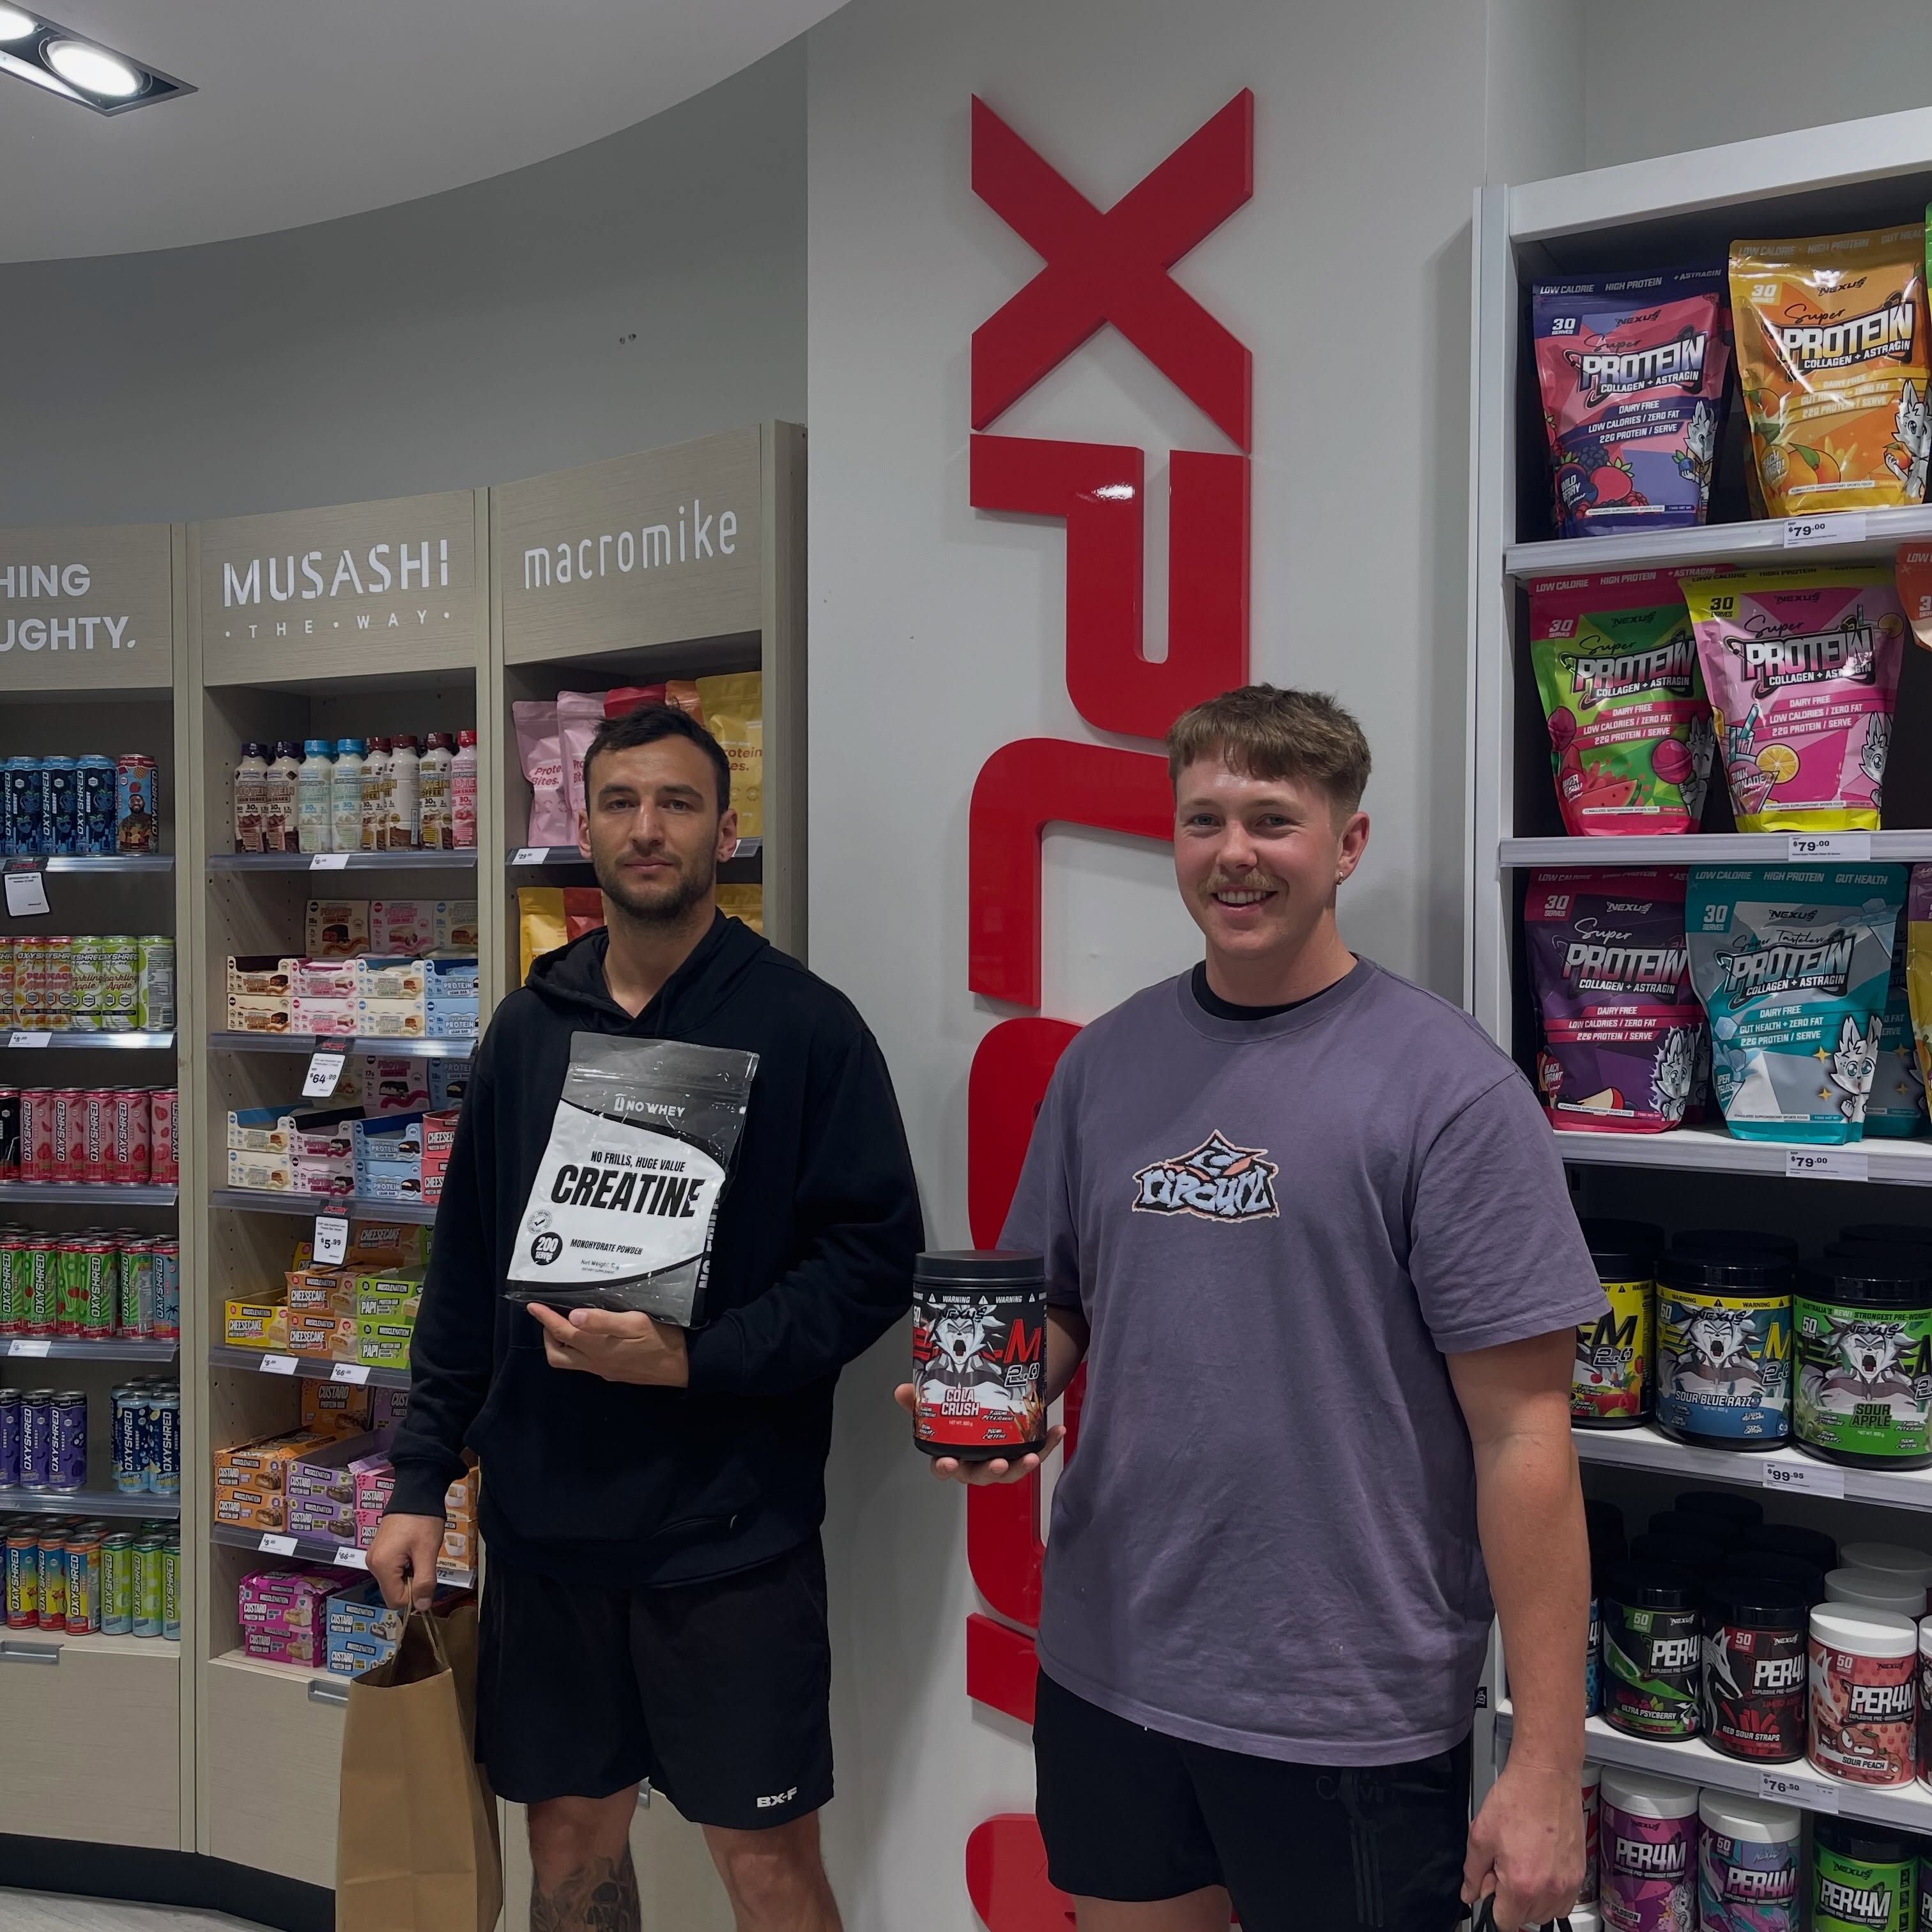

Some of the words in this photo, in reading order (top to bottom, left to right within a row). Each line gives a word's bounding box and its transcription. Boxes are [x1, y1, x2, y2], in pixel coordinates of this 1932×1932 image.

[1540, 286, 1560, 295] LOW
[1562, 284, 1595, 294] CALORIE
[1605, 282, 1626, 291] HIGH
[1627, 277, 1662, 289] PROTEIN
[1751, 284, 1777, 297] 30
[1552, 318, 1576, 330] 30
[1615, 310, 1661, 326] NEXUS
[1782, 303, 1913, 360] PROTEIN
[1584, 333, 1641, 353] Super
[1579, 335, 1705, 390] PROTEIN
[1804, 356, 1852, 369] COLLAGEN
[1864, 340, 1910, 359] ASTRAGIN
[1600, 381, 1644, 394] COLLAGEN
[1655, 371, 1699, 385] ASTRAGIN
[1619, 402, 1641, 414] DAIRY
[1642, 400, 1660, 411] FREE
[1588, 424, 1607, 433] LOW
[1607, 416, 1641, 429] CALORIES
[1648, 412, 1666, 422] ZERO
[1667, 410, 1680, 418] FAT
[1599, 433, 1615, 444] 22G
[1616, 428, 1647, 440] PROTEIN
[1653, 424, 1677, 434] SERVE
[1788, 523, 1825, 537] $79.00
[524, 499, 738, 590] macromike
[224, 539, 448, 608] MUSASHI
[1710, 597, 1734, 611] 30
[249, 619, 313, 639] THE
[356, 610, 427, 630] WAY
[1549, 620, 1574, 632] 30
[1744, 615, 1804, 638] Super
[1579, 635, 1636, 654] Super
[1744, 628, 1873, 680] PROTEIN
[1573, 641, 1696, 692] PROTEIN
[1597, 682, 1640, 697] COLLAGEN
[1650, 676, 1690, 687] ASTRAGIN
[1769, 673, 1814, 686] COLLAGEN
[1790, 698, 1812, 709] DAIRY
[1813, 695, 1831, 705] FREE
[1770, 714, 1788, 724] LOW
[1788, 709, 1825, 721] CALORIES
[1831, 705, 1849, 714] ZERO
[1850, 703, 1863, 712] FAT
[1772, 726, 1788, 737] 22G
[1790, 721, 1821, 734] PROTEIN
[1828, 717, 1852, 728] SERVE
[1793, 840, 1830, 852] $79.00
[1696, 871, 1716, 880] LOW
[1717, 871, 1753, 880] CALORIE
[1763, 871, 1787, 881] HIGH
[1788, 872, 1825, 882] PROTEIN
[1835, 873, 1854, 884] GUT
[1855, 875, 1888, 885] HEALTH
[1544, 895, 1570, 910] 30
[1606, 901, 1653, 914] NEXUS
[1703, 905, 1728, 923] 30
[1768, 909, 1818, 921] NEXUS
[1574, 917, 1632, 944] Super
[1563, 943, 1687, 983] PROTEIN
[1726, 935, 1855, 992] PROTEIN
[1579, 979, 1623, 992] COLLAGEN
[1634, 983, 1675, 994] ASTRAGIN
[1746, 979, 1789, 996] COLLAGEN
[1799, 974, 1844, 987] ASTRAGIN
[1759, 1008, 1781, 1018] DAIRY
[1781, 1006, 1802, 1016] FREE
[1739, 1024, 1754, 1034] GUT
[1756, 1021, 1781, 1032] HEALTH
[1789, 1018, 1810, 1028] ZERO
[1811, 1016, 1824, 1027] FAT
[309, 1073, 337, 1084] $64.99
[90, 1101, 99, 1162] OXYSHRED
[119, 1101, 127, 1163] OXYSHRED
[591, 1151, 603, 1163] NO
[604, 1153, 633, 1169] FRILLS,
[635, 1157, 659, 1170] HUGE
[661, 1159, 686, 1172] VALUE
[1791, 1156, 1828, 1168] $79.00
[373, 1183, 401, 1191] PROTEIN
[551, 1164, 706, 1218] CREATINE
[321, 1237, 341, 1249] $5.99
[535, 1236, 558, 1253] 200
[571, 1238, 616, 1252] MONOHYDRATE
[618, 1245, 643, 1255] POWDER
[35, 1254, 45, 1314] OXYSHRED
[91, 1257, 101, 1318] OXYSHRED
[291, 1289, 326, 1302] CHEESECAKE
[942, 1295, 970, 1303] WARNING
[995, 1295, 1023, 1304] WARNING
[360, 1301, 376, 1315] PAPI
[1742, 1301, 1771, 1309] WARNING
[1833, 1308, 1853, 1318] NEW!
[1854, 1312, 1893, 1321] STRONGEST
[228, 1319, 263, 1331] CHEESECAKE
[1802, 1315, 1818, 1334] 50
[362, 1344, 378, 1358] PAPI
[1593, 1346, 1634, 1367] 2.0
[1004, 1362, 1040, 1388] 2.0
[318, 1384, 350, 1400] CUSTARD
[946, 1388, 975, 1402] COLA
[1675, 1391, 1699, 1404] SOUR
[1700, 1393, 1726, 1406] BLUE
[1728, 1395, 1752, 1407] RAZZ
[941, 1402, 980, 1416] CRUSH
[1855, 1404, 1891, 1416] SOUR
[1851, 1414, 1892, 1428] APPLE
[125, 1411, 133, 1471] OXYSHRED
[290, 1476, 311, 1489] CUSTARD
[1767, 1468, 1804, 1482] $99.95
[362, 1490, 384, 1501] CUSTARD
[11, 1549, 20, 1610] OXYSHRED
[71, 1554, 79, 1616] OXYSHRED
[1735, 1632, 1751, 1646] 50
[1851, 1680, 1915, 1713] PER4M
[1621, 1705, 1639, 1715] ULTRA
[1639, 1708, 1677, 1720] PSYCBERRY
[1722, 1726, 1735, 1735] RED
[1735, 1729, 1754, 1740] SOUR
[1754, 1733, 1781, 1742] STRAPS
[1842, 1756, 1860, 1768] SOUR
[1862, 1758, 1885, 1769] PEACH
[1763, 1778, 1800, 1792] $76.50
[1717, 1837, 1731, 1851] 50
[1616, 1837, 1687, 1871] PER4M
[1832, 1860, 1873, 1880] NEXUS
[1727, 1866, 1796, 1899] PER4M
[1821, 1878, 1892, 1917] PER4M
